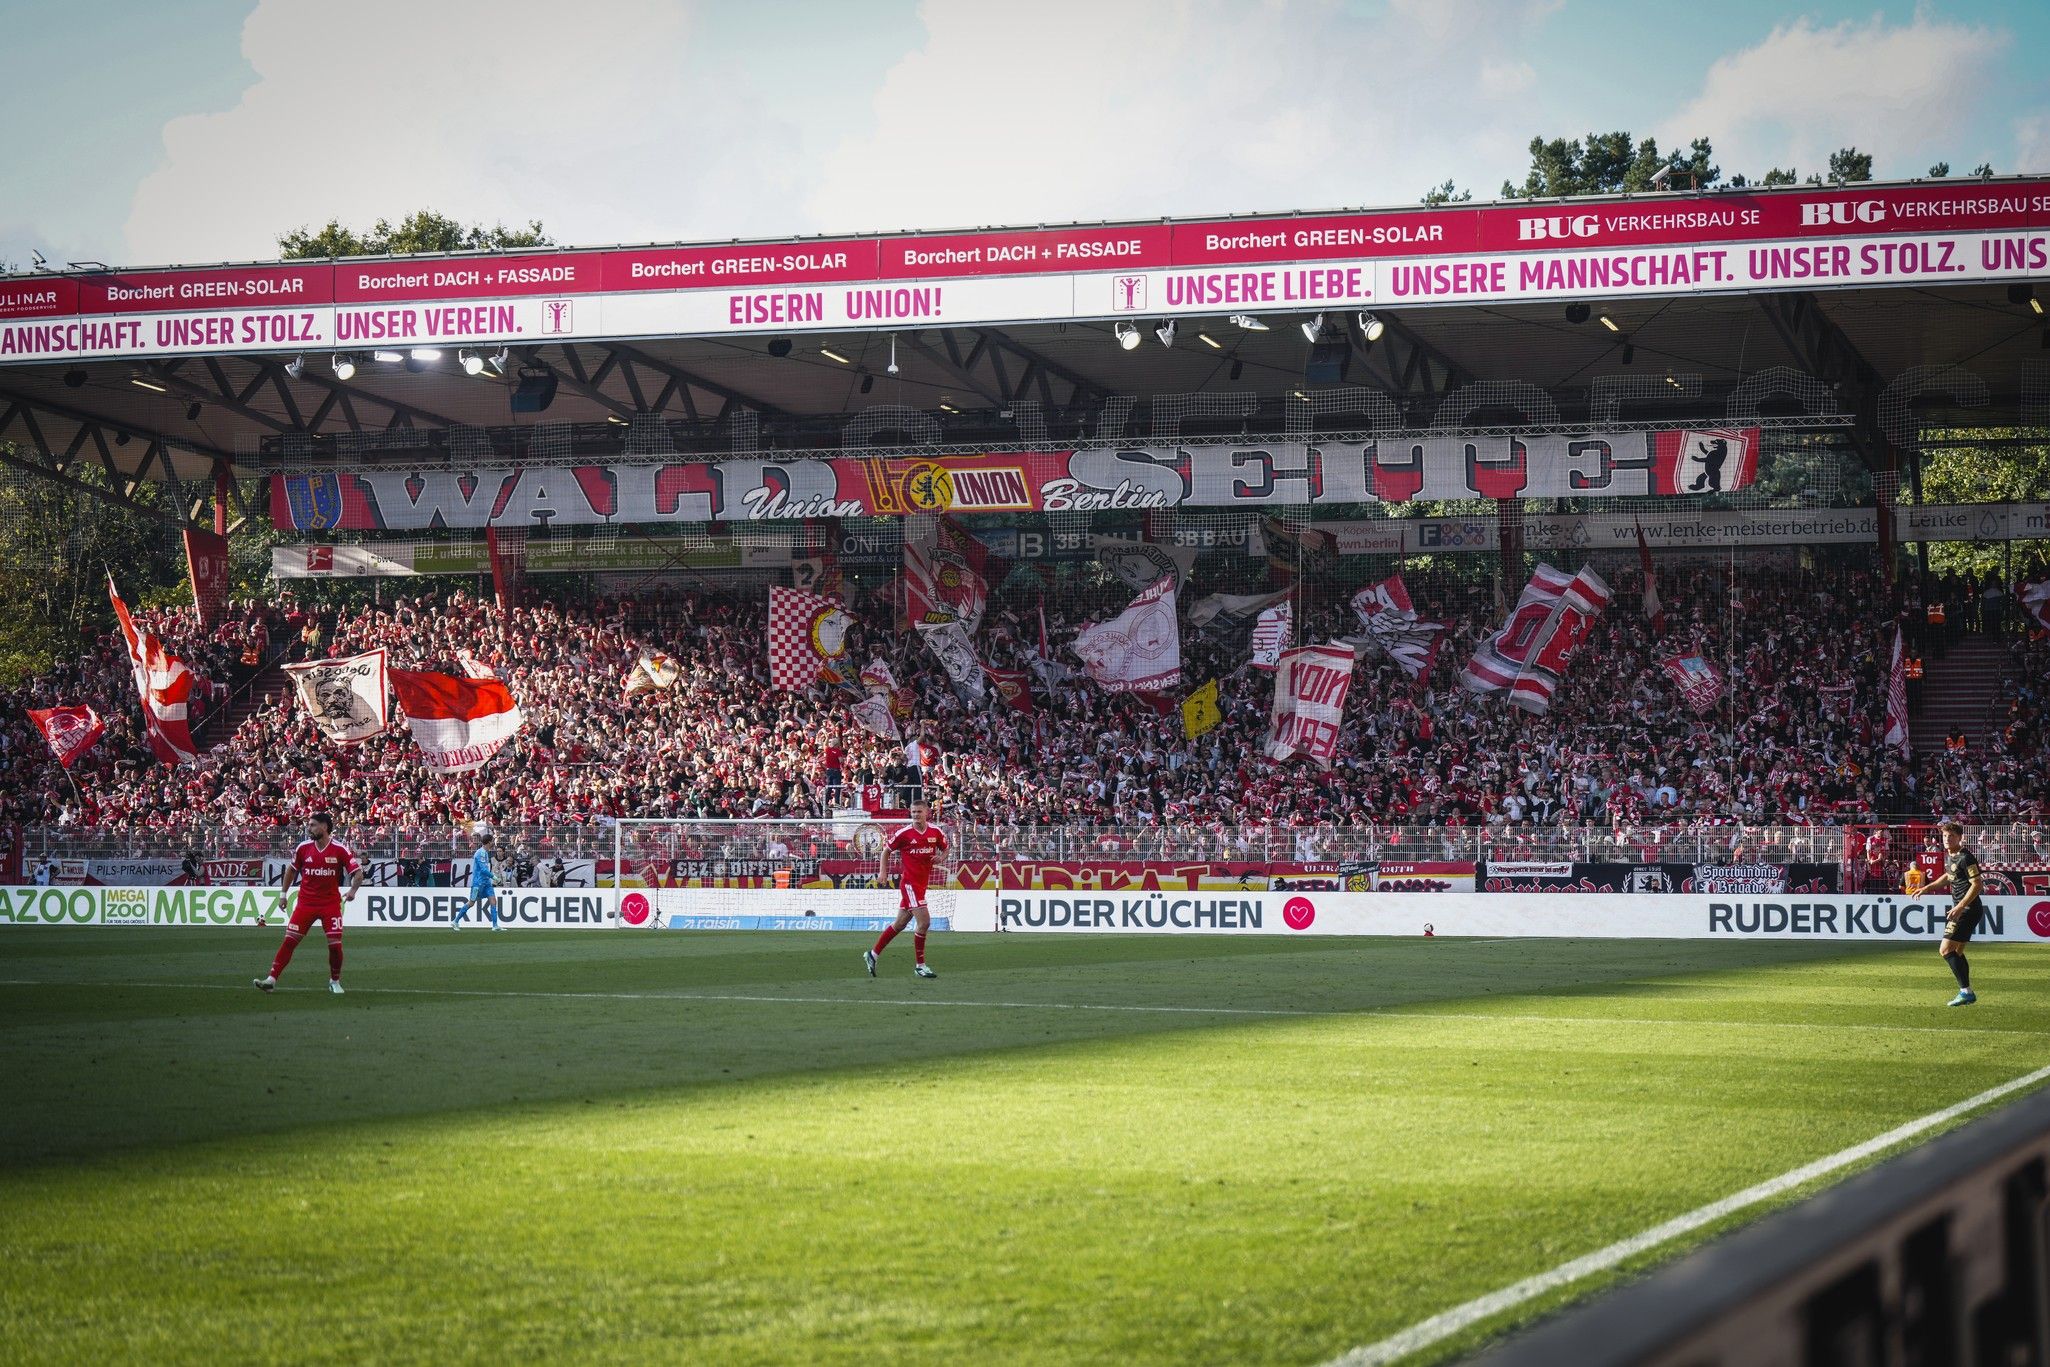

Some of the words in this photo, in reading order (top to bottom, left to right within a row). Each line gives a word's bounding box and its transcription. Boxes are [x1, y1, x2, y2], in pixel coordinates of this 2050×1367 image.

[1800, 200, 1887, 227] BUG
[1892, 196, 2027, 219] VERKEHRSBAU
[1206, 231, 1287, 251] Borchert
[1294, 225, 1443, 247] GREEN-SOLAR
[1517, 214, 1601, 241] BUG
[1605, 211, 1736, 233] VERKEHRSBAU
[1740, 209, 1761, 225] SE
[904, 246, 981, 265] Borchert
[987, 244, 1037, 262] DACH
[1057, 239, 1142, 259] FASSADE
[358, 272, 429, 290] Borchert
[433, 270, 480, 286] DACH
[498, 266, 576, 285] FASSADE
[631, 260, 705, 278] Borchert
[711, 253, 848, 274] GREEN-SOLAR
[1166, 271, 1277, 306] UNSERE
[1284, 267, 1372, 302] LIEBE.
[1392, 262, 1506, 297] UNSERE
[1520, 250, 1735, 292] MANNSCHAFT.
[1748, 245, 1851, 281] UNSER
[1860, 240, 1966, 276] STOLZ.
[107, 284, 175, 302] Borchert
[180, 278, 304, 298] GREEN-SOLAR
[729, 292, 824, 325] EISERN
[845, 287, 943, 320] UNION!
[156, 316, 235, 348] UNSER
[241, 312, 322, 344] STOLZ.
[336, 309, 417, 341] UNSER
[424, 304, 523, 336] VEREIN.
[1068, 432, 1653, 507] SEITE
[358, 458, 838, 528] WALD
[952, 470, 1027, 505] UNION
[1041, 477, 1168, 512] Berlin
[742, 487, 864, 520] Union
[1203, 529, 1246, 547] BAU
[96, 864, 174, 876] PILS-PIRANHAS
[310, 867, 336, 877] raisin
[1921, 854, 1938, 865] Tor
[1925, 868, 1933, 879] 2
[107, 889, 146, 902] MEGA
[367, 895, 470, 922] RUDER
[107, 903, 146, 918] ZOO
[331, 917, 343, 930] 30
[698, 916, 740, 930] raisin
[791, 916, 834, 930] raisin
[1001, 899, 1115, 927] RUDER
[1122, 893, 1263, 928] KÜCHEN
[1709, 903, 1838, 933] RUDER
[1850, 897, 2004, 935] KÜCHN
